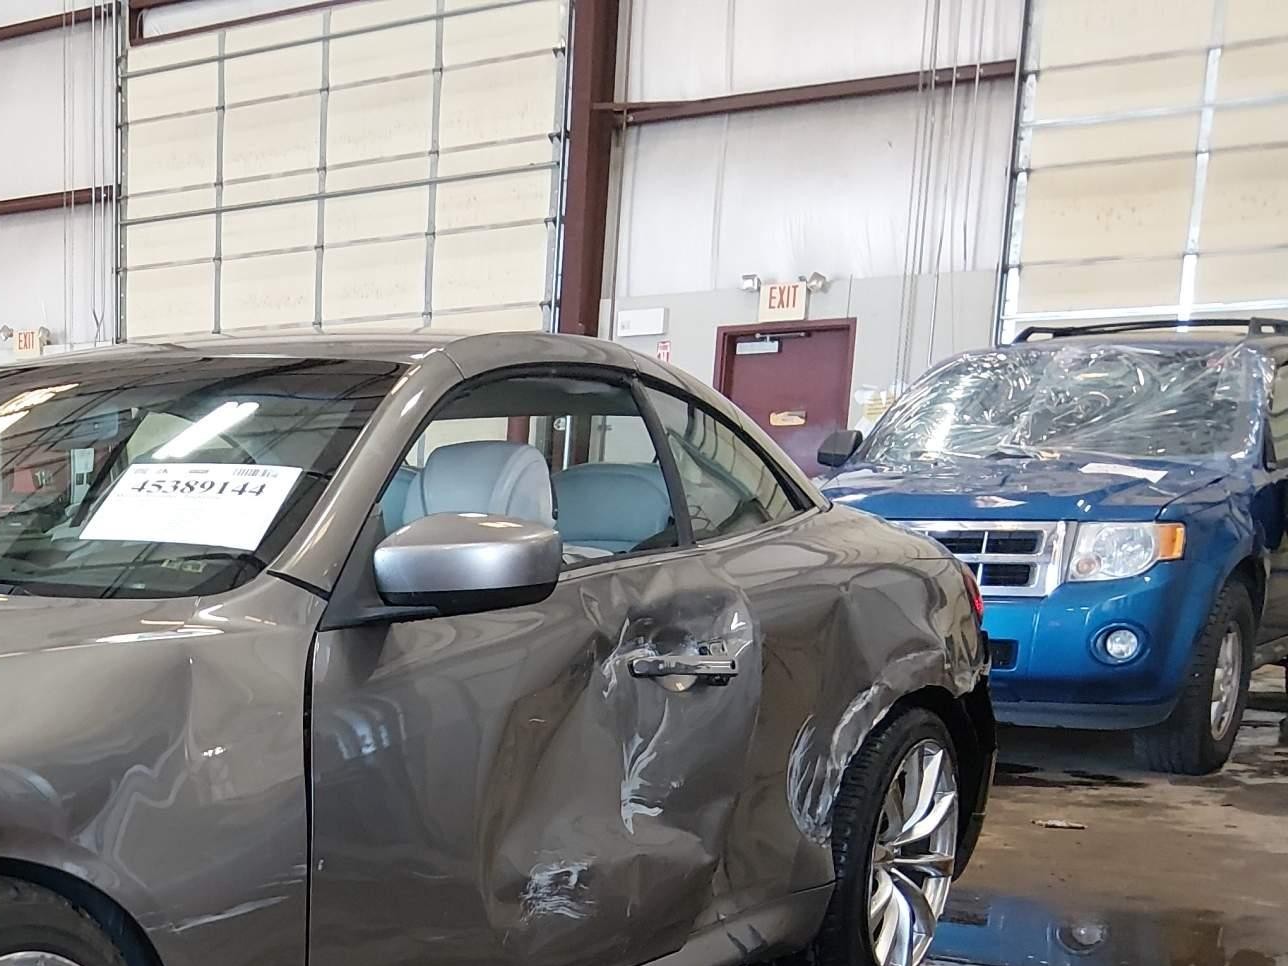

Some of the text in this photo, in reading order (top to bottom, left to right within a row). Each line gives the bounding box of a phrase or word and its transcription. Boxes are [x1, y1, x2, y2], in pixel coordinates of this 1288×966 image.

[769, 285, 799, 309] EXIT
[18, 332, 35, 350] EXIT
[130, 479, 266, 497] 45389144
